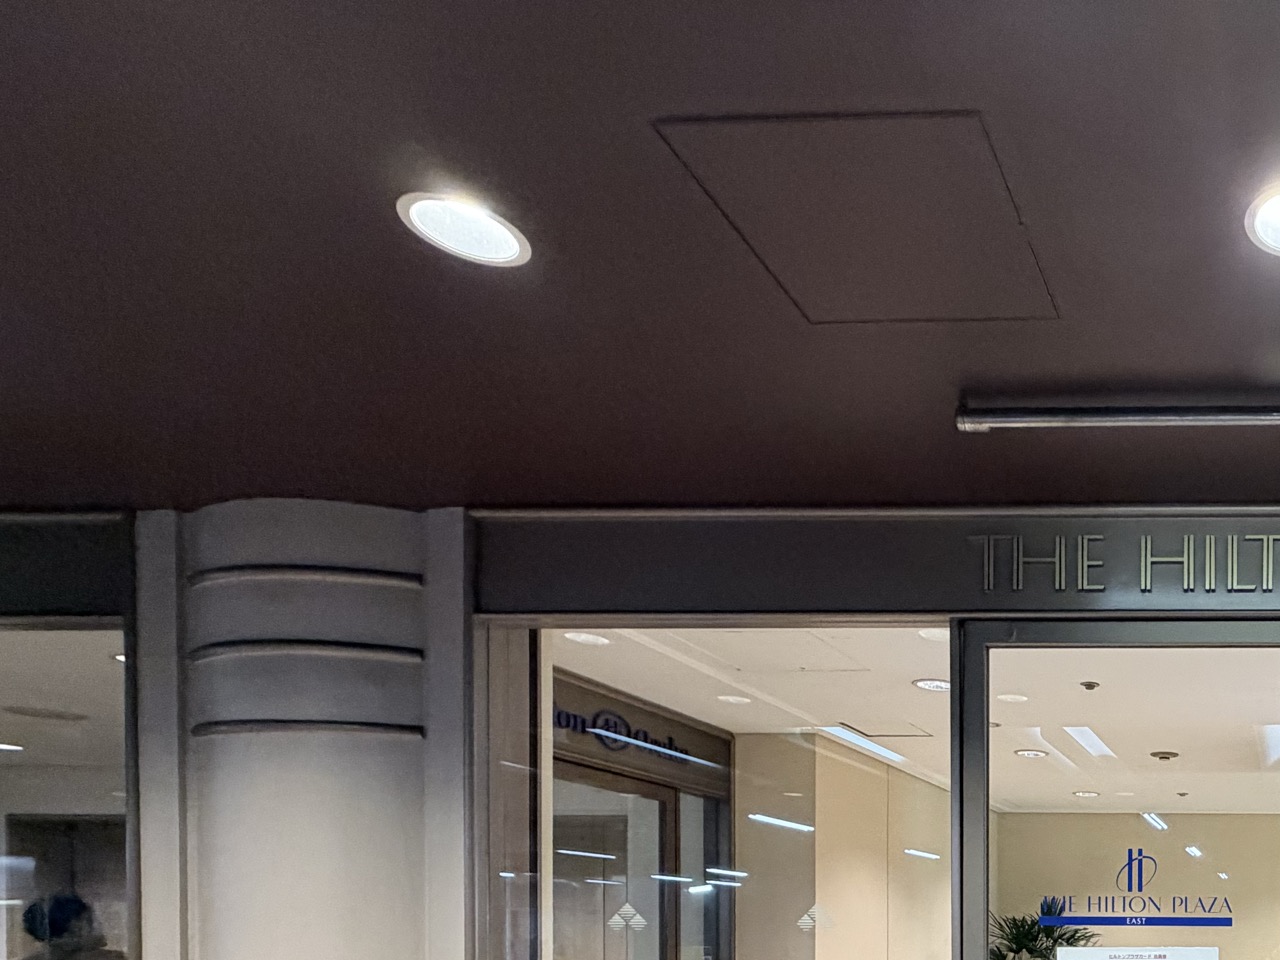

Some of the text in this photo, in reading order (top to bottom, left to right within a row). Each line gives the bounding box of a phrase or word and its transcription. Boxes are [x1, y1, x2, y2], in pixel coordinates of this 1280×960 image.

[967, 533, 1105, 591] THE
[1087, 895, 1162, 913] HILTON
[1172, 896, 1233, 914] PLAZA
[1126, 917, 1146, 925] EAST
